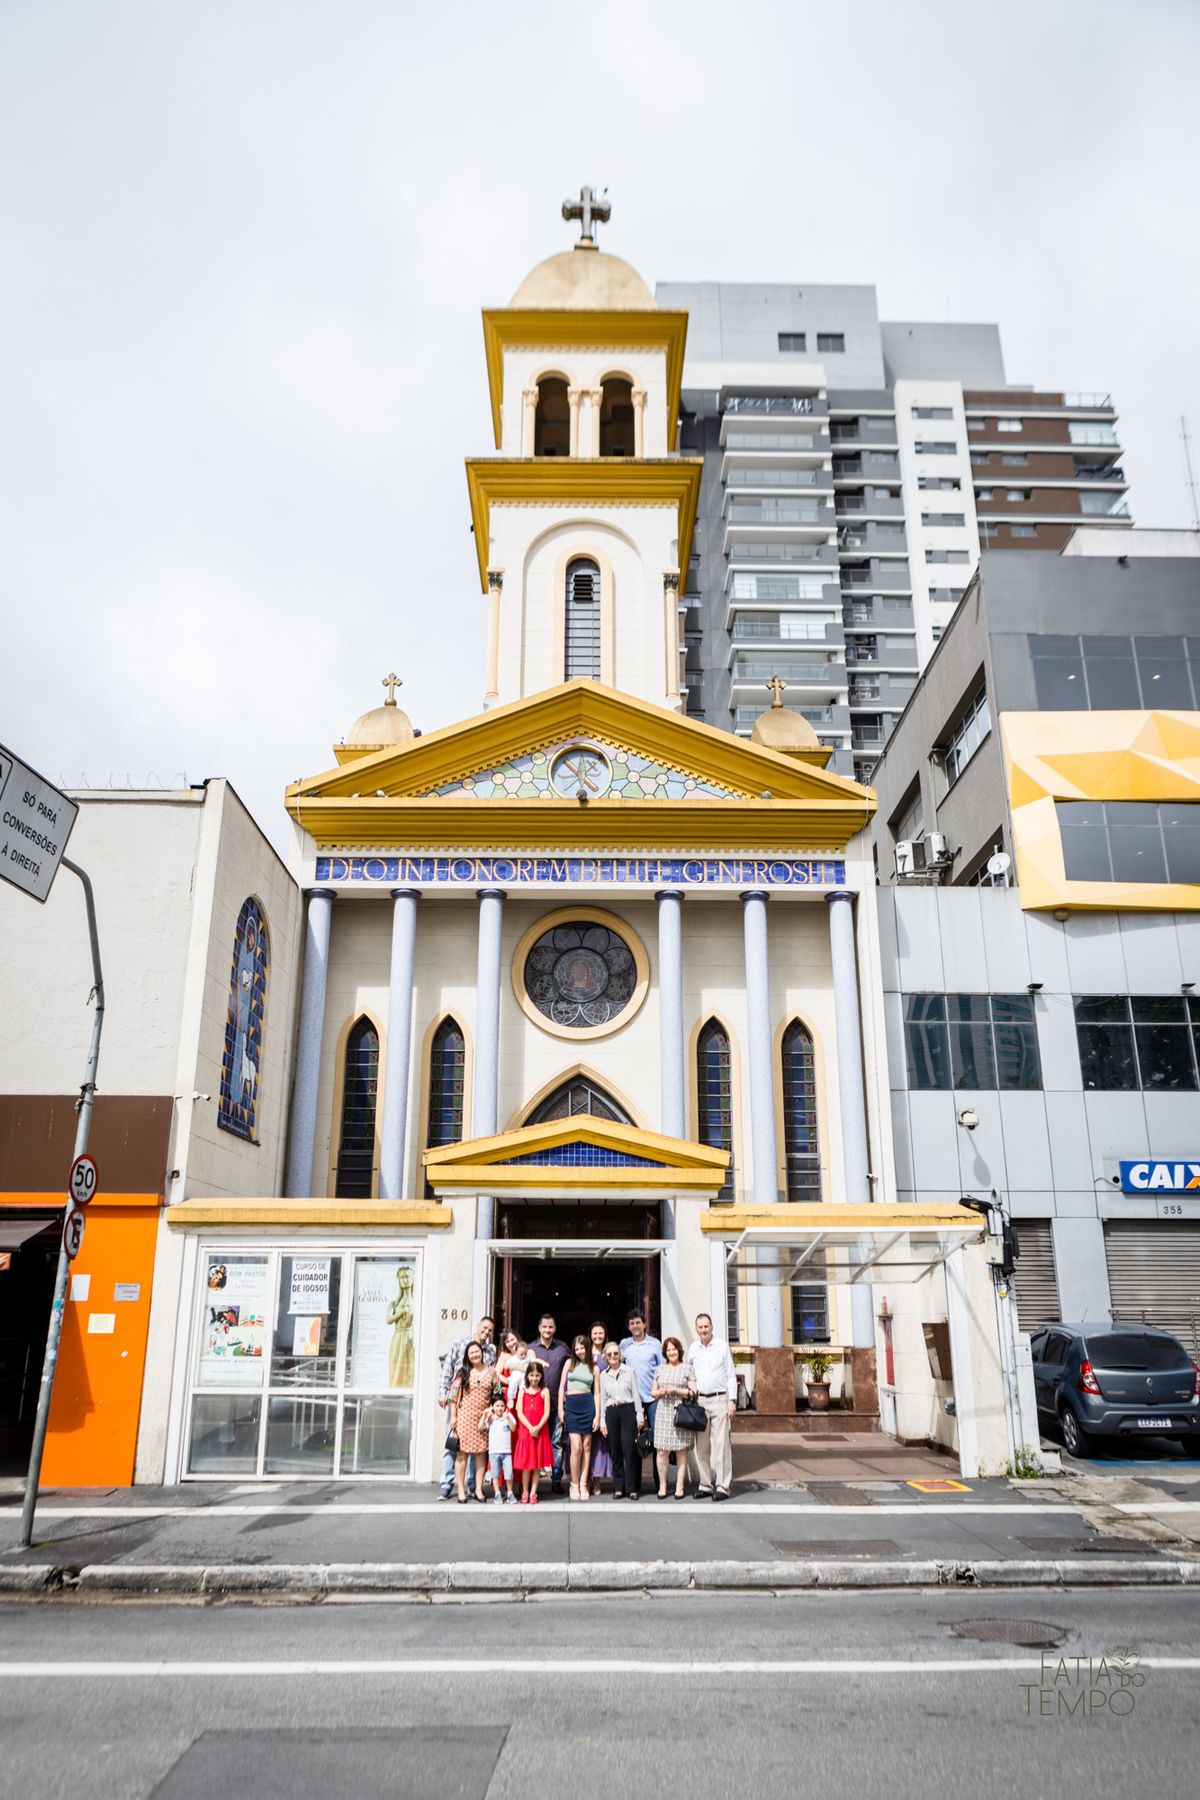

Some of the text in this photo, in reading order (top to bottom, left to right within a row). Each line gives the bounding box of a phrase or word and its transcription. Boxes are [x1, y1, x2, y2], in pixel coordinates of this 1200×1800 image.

[23, 791, 57, 824] SÓ PARA
[3, 811, 57, 856] CONVERSÕES
[10, 849, 40, 876] DIREITA
[327, 858, 388, 881] DEO
[396, 858, 425, 881] IN
[432, 858, 572, 882] HONOREM
[74, 1165, 94, 1189] 50
[1163, 1205, 1183, 1214] 358
[292, 1284, 328, 1292] DE IDOSOS
[293, 1273, 328, 1281] CUIDADOR
[441, 1308, 468, 1320] 360
